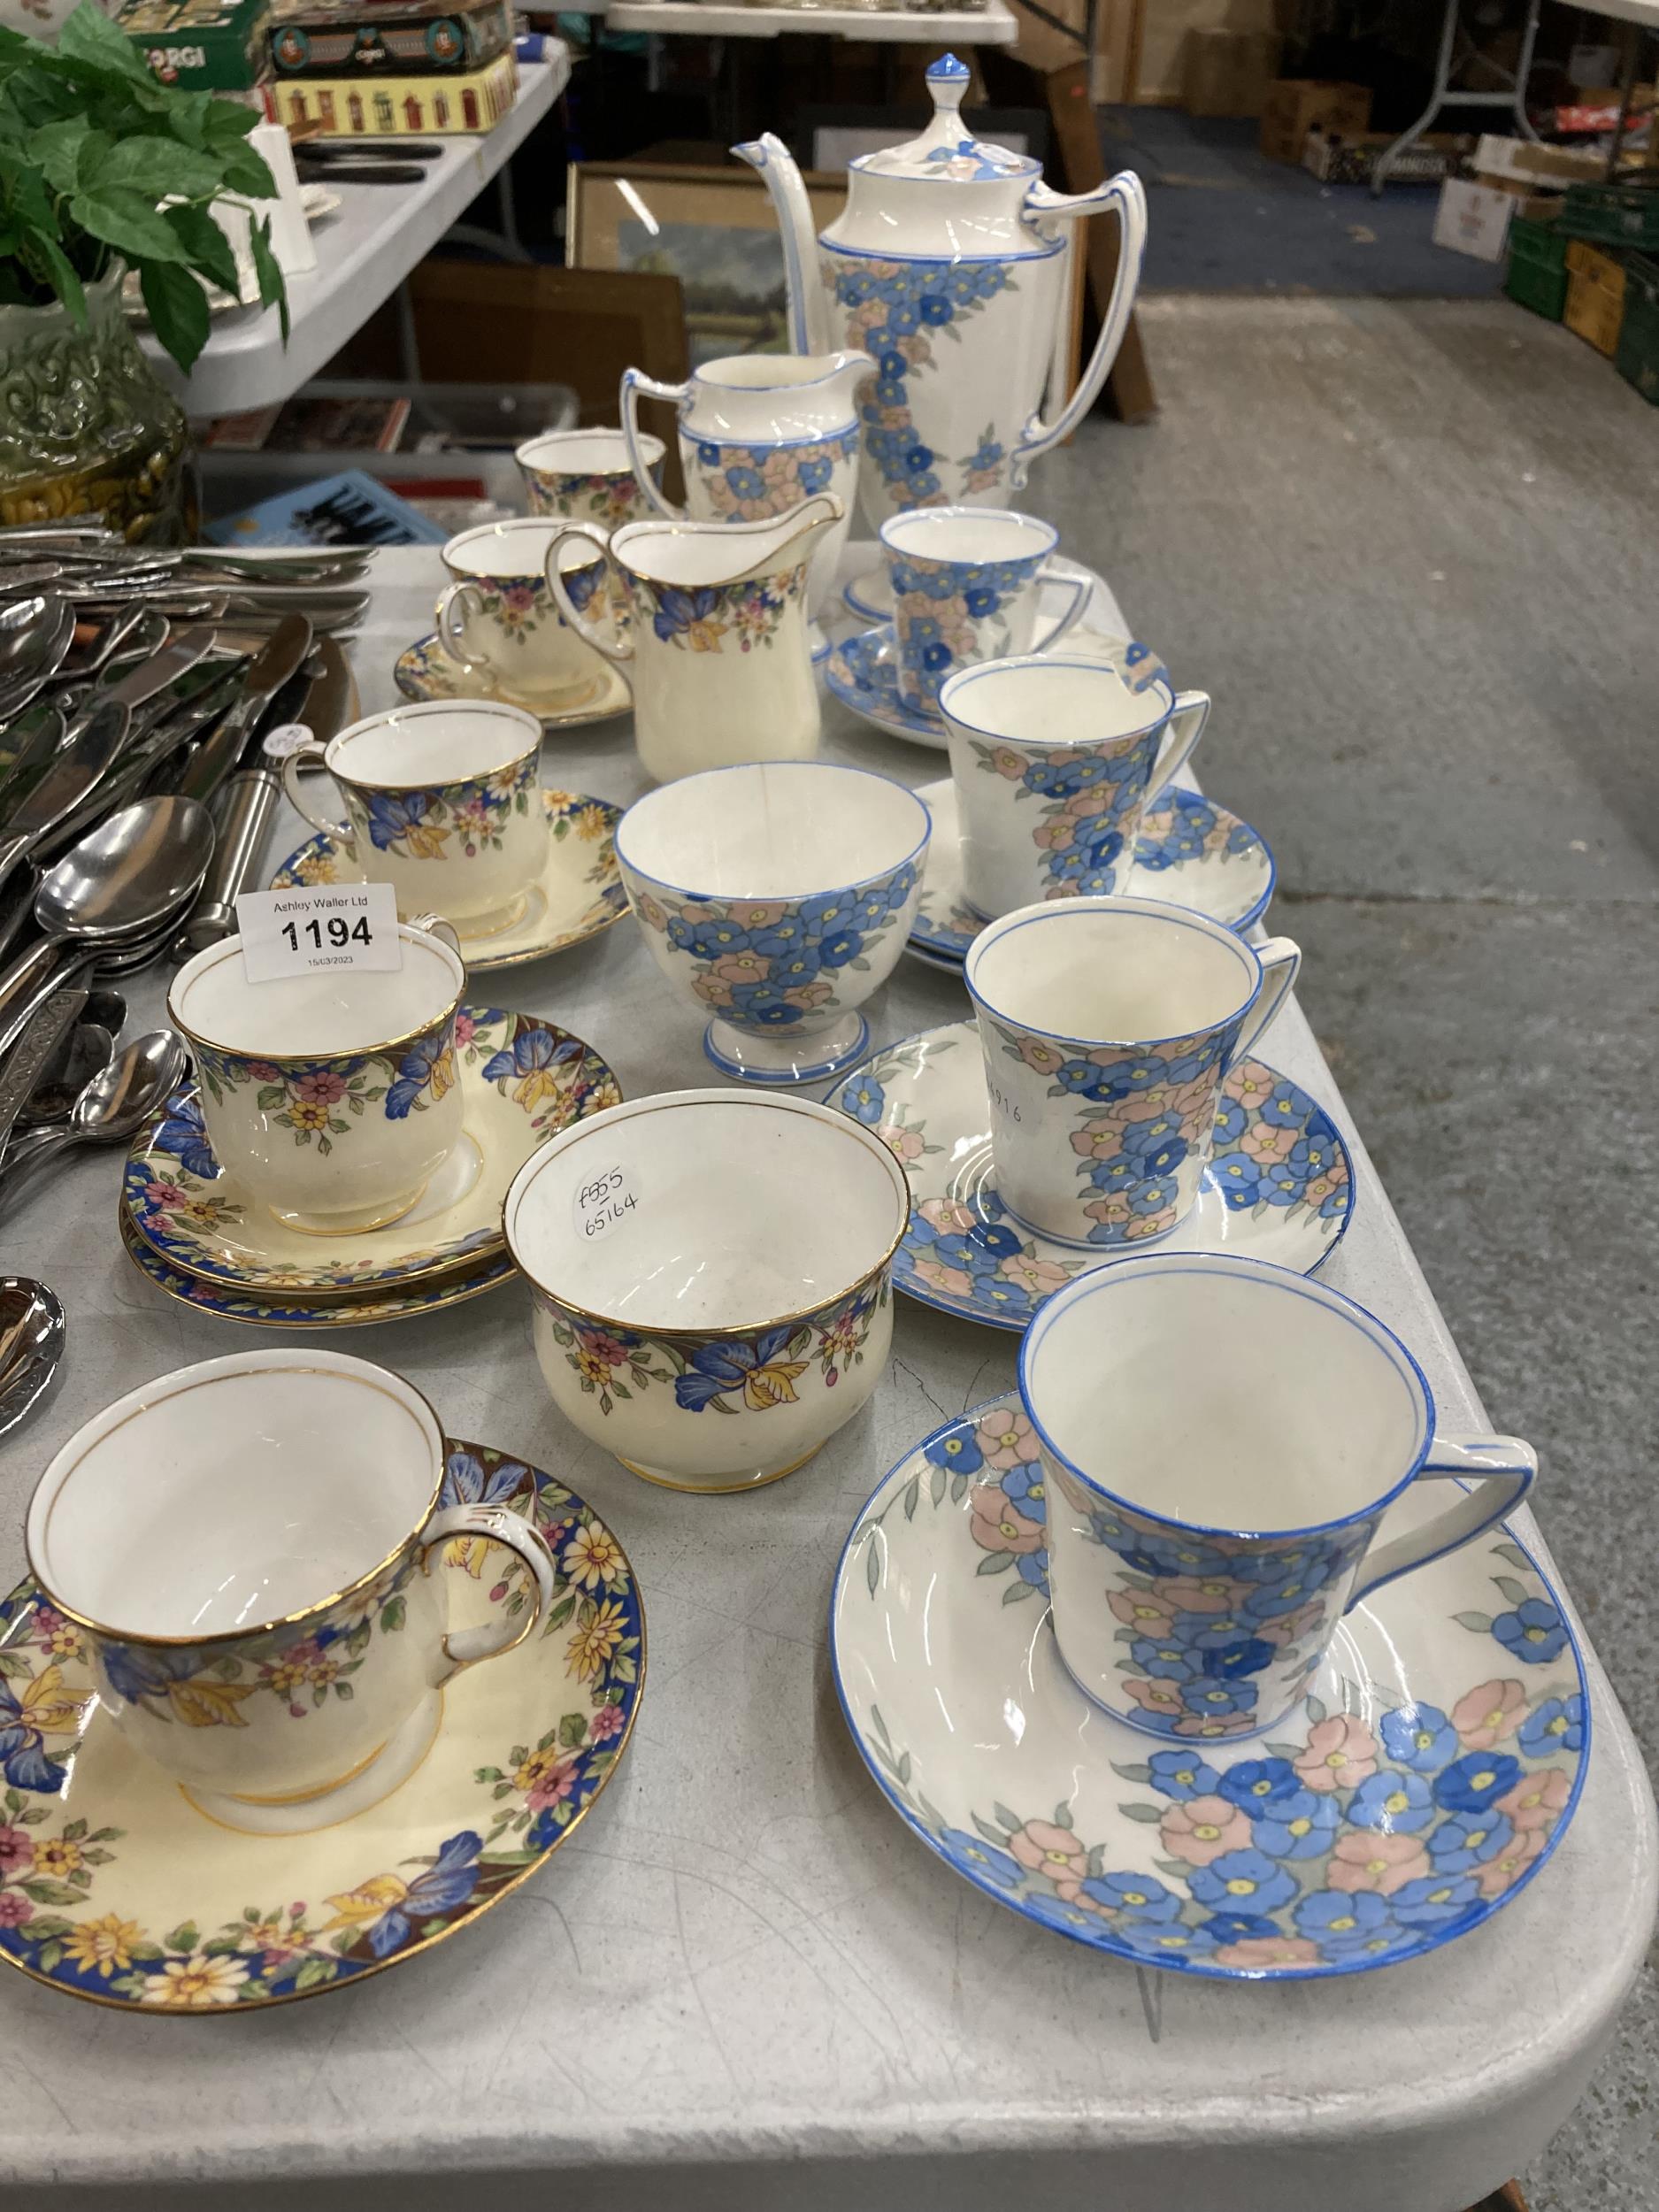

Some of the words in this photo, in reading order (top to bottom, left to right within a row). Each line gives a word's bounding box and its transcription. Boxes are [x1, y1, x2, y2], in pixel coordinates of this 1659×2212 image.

[143, 46, 207, 69] ORGI
[273, 901, 311, 914] Ashley
[313, 897, 349, 910] Waller
[351, 895, 368, 907] Ltd
[281, 916, 373, 952] 1194
[308, 956, 354, 967] 15/03/2023
[585, 1192, 639, 1237] 65164
